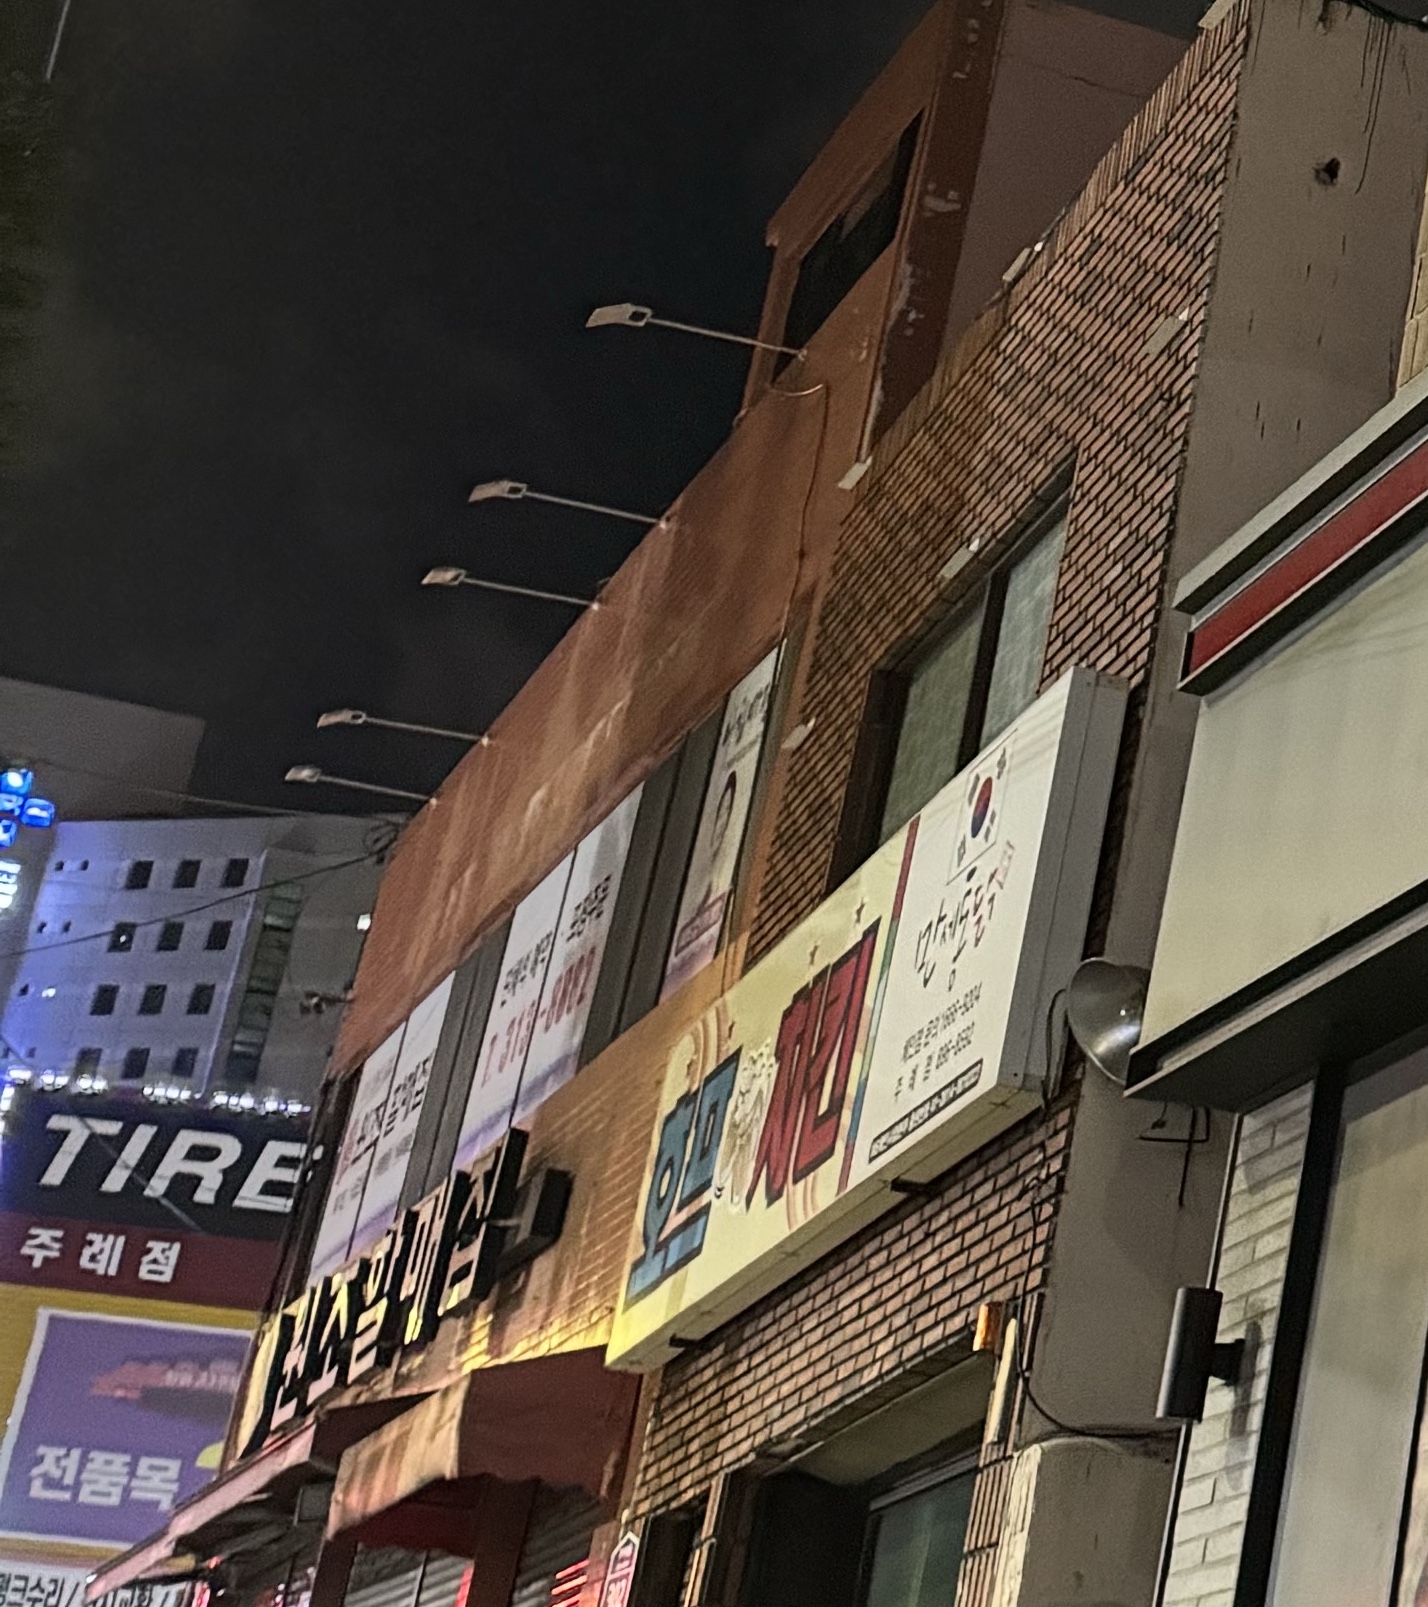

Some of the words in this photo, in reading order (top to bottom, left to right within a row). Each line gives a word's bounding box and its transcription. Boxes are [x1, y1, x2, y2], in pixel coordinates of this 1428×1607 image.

[746, 915, 882, 1213] 치킨
[38, 1113, 318, 1213] TIRE
[20, 1227, 182, 1284] 주례점
[28, 1444, 182, 1512] 전품목
